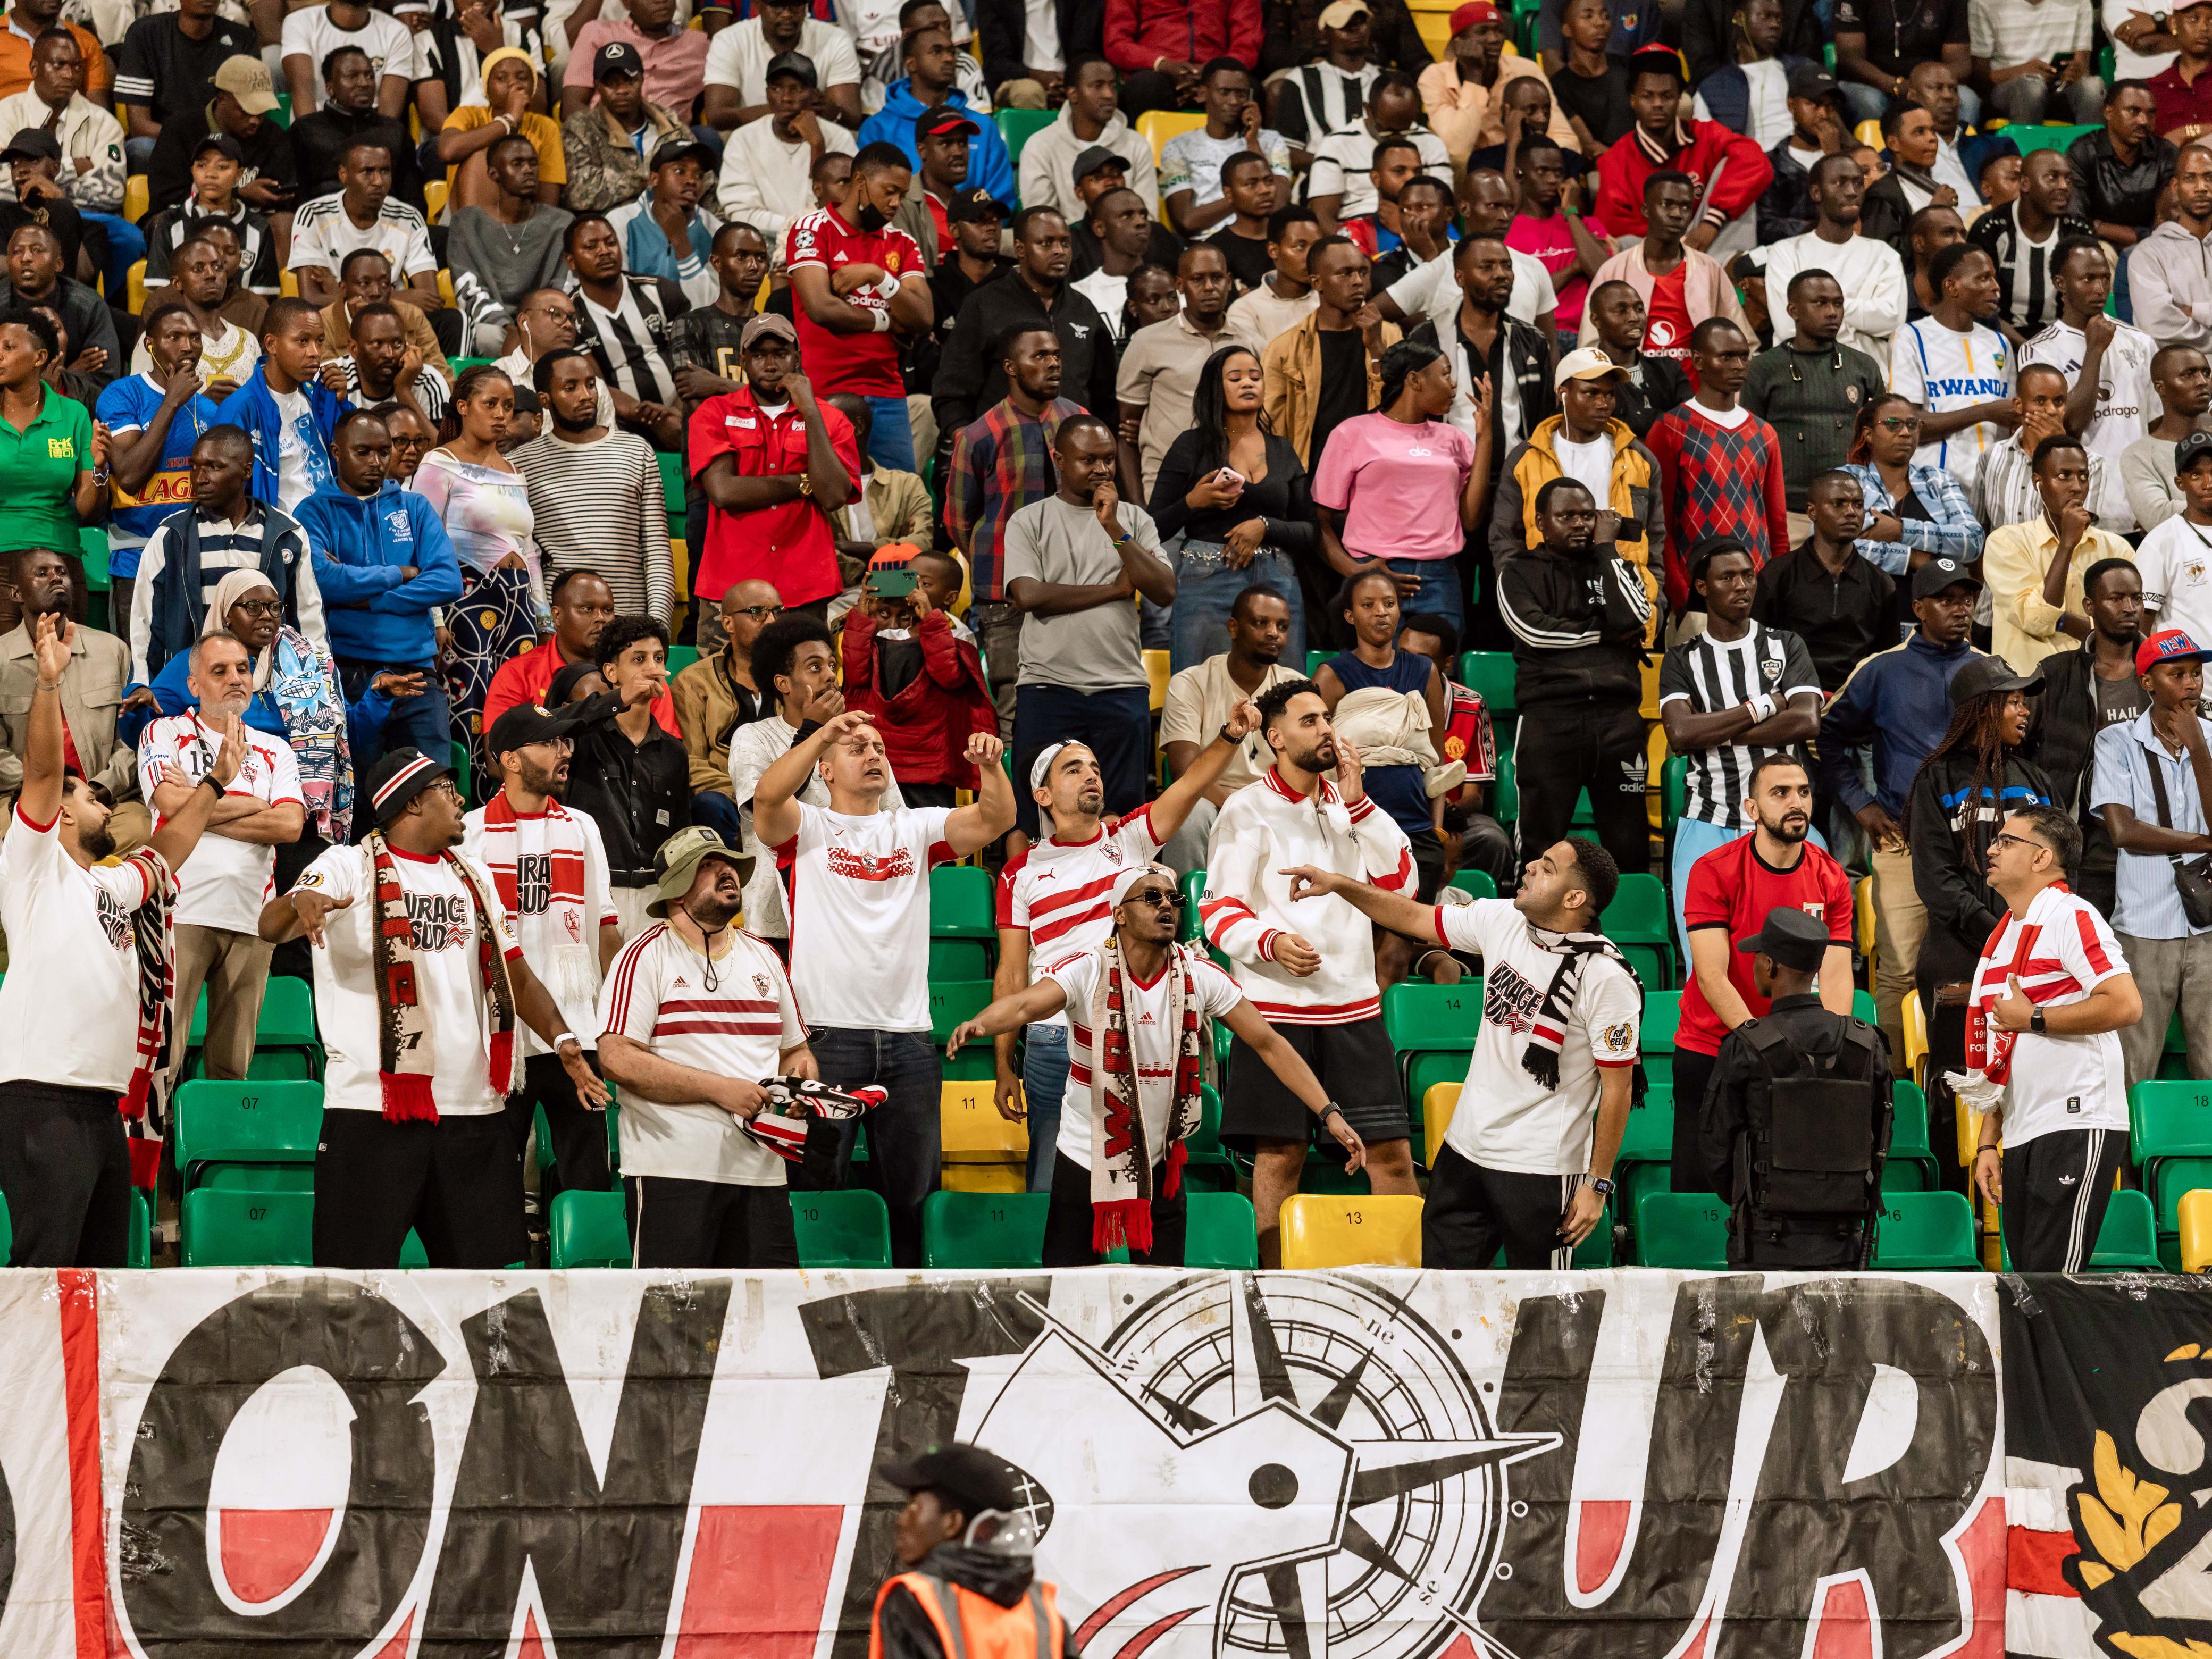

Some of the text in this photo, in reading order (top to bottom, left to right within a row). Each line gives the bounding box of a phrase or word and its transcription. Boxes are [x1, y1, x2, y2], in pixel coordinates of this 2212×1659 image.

[1590, 349, 1609, 363] LA
[2157, 632, 2188, 656] NEW
[2106, 707, 2139, 721] HAIL
[190, 750, 214, 776] 18
[1488, 960, 1545, 1020] VIRAGE
[932, 996, 944, 1006] 11
[1446, 1000, 1460, 1009] 14
[1974, 1017, 1985, 1026] ES
[1612, 1028, 1626, 1037] RIP
[242, 1097, 258, 1109] 07
[962, 1098, 974, 1109] 11
[2194, 1096, 2208, 1107] 18
[250, 1208, 266, 1220] 07
[803, 1209, 818, 1220] 10
[991, 1210, 1003, 1221] 11
[1346, 1212, 1362, 1224] 13
[1703, 1210, 1718, 1221] 15
[1887, 1210, 1901, 1221] 16
[1419, 1581, 1440, 1606] se
